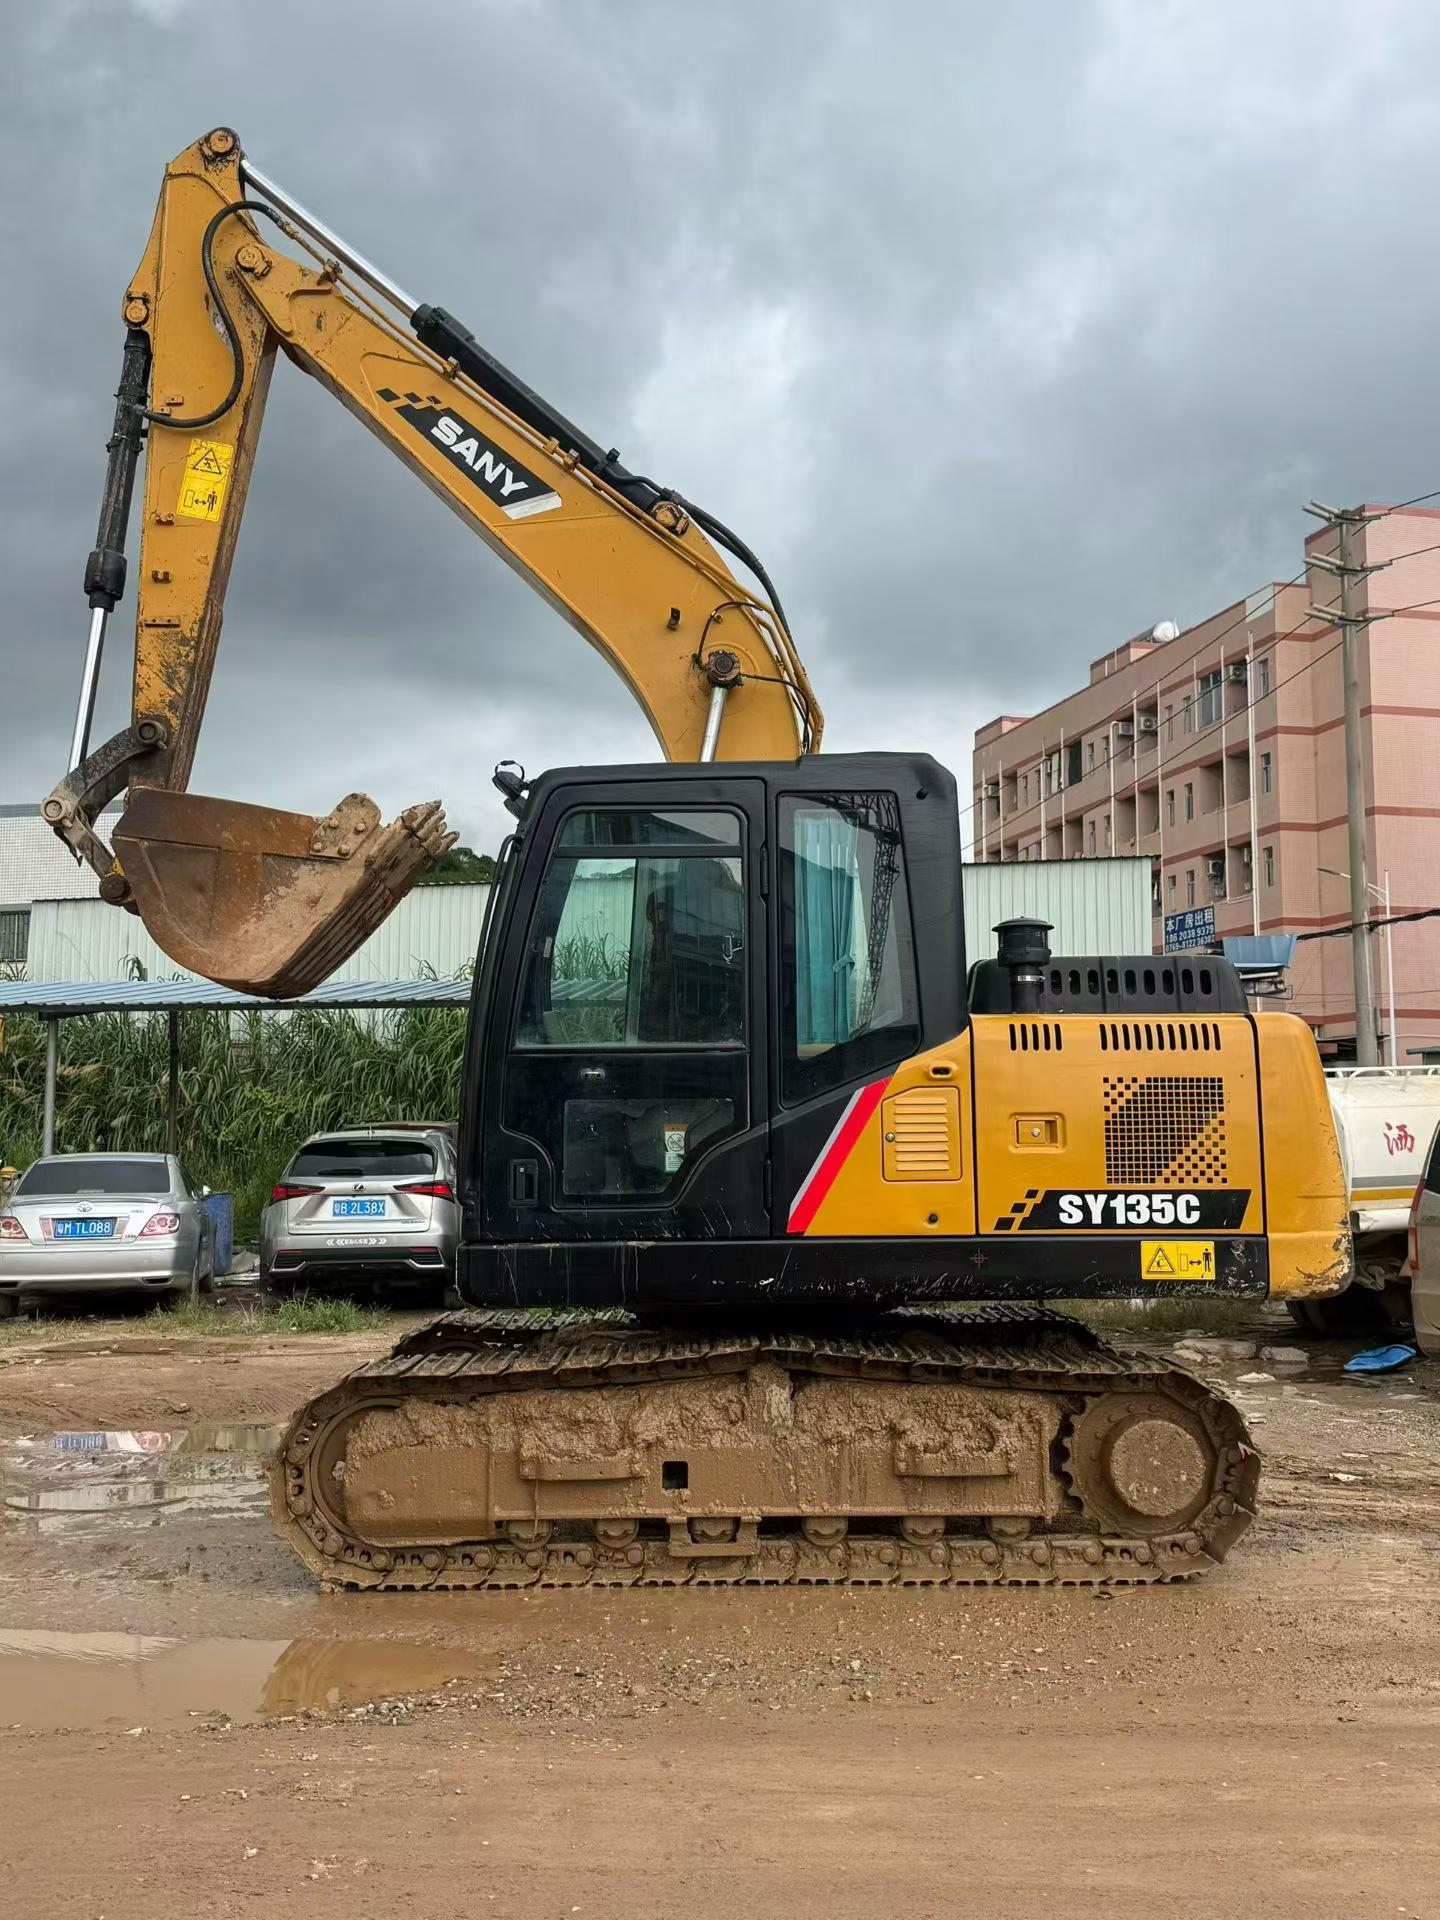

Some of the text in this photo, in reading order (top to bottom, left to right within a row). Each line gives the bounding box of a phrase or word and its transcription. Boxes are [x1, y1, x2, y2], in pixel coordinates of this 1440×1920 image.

[431, 416, 529, 497] SANY
[1166, 908, 1213, 932] 本厂房出租
[1166, 924, 1214, 944] 186 2038 9379
[1383, 1121, 1415, 1155] 洒
[1058, 1193, 1200, 1225] SY135C
